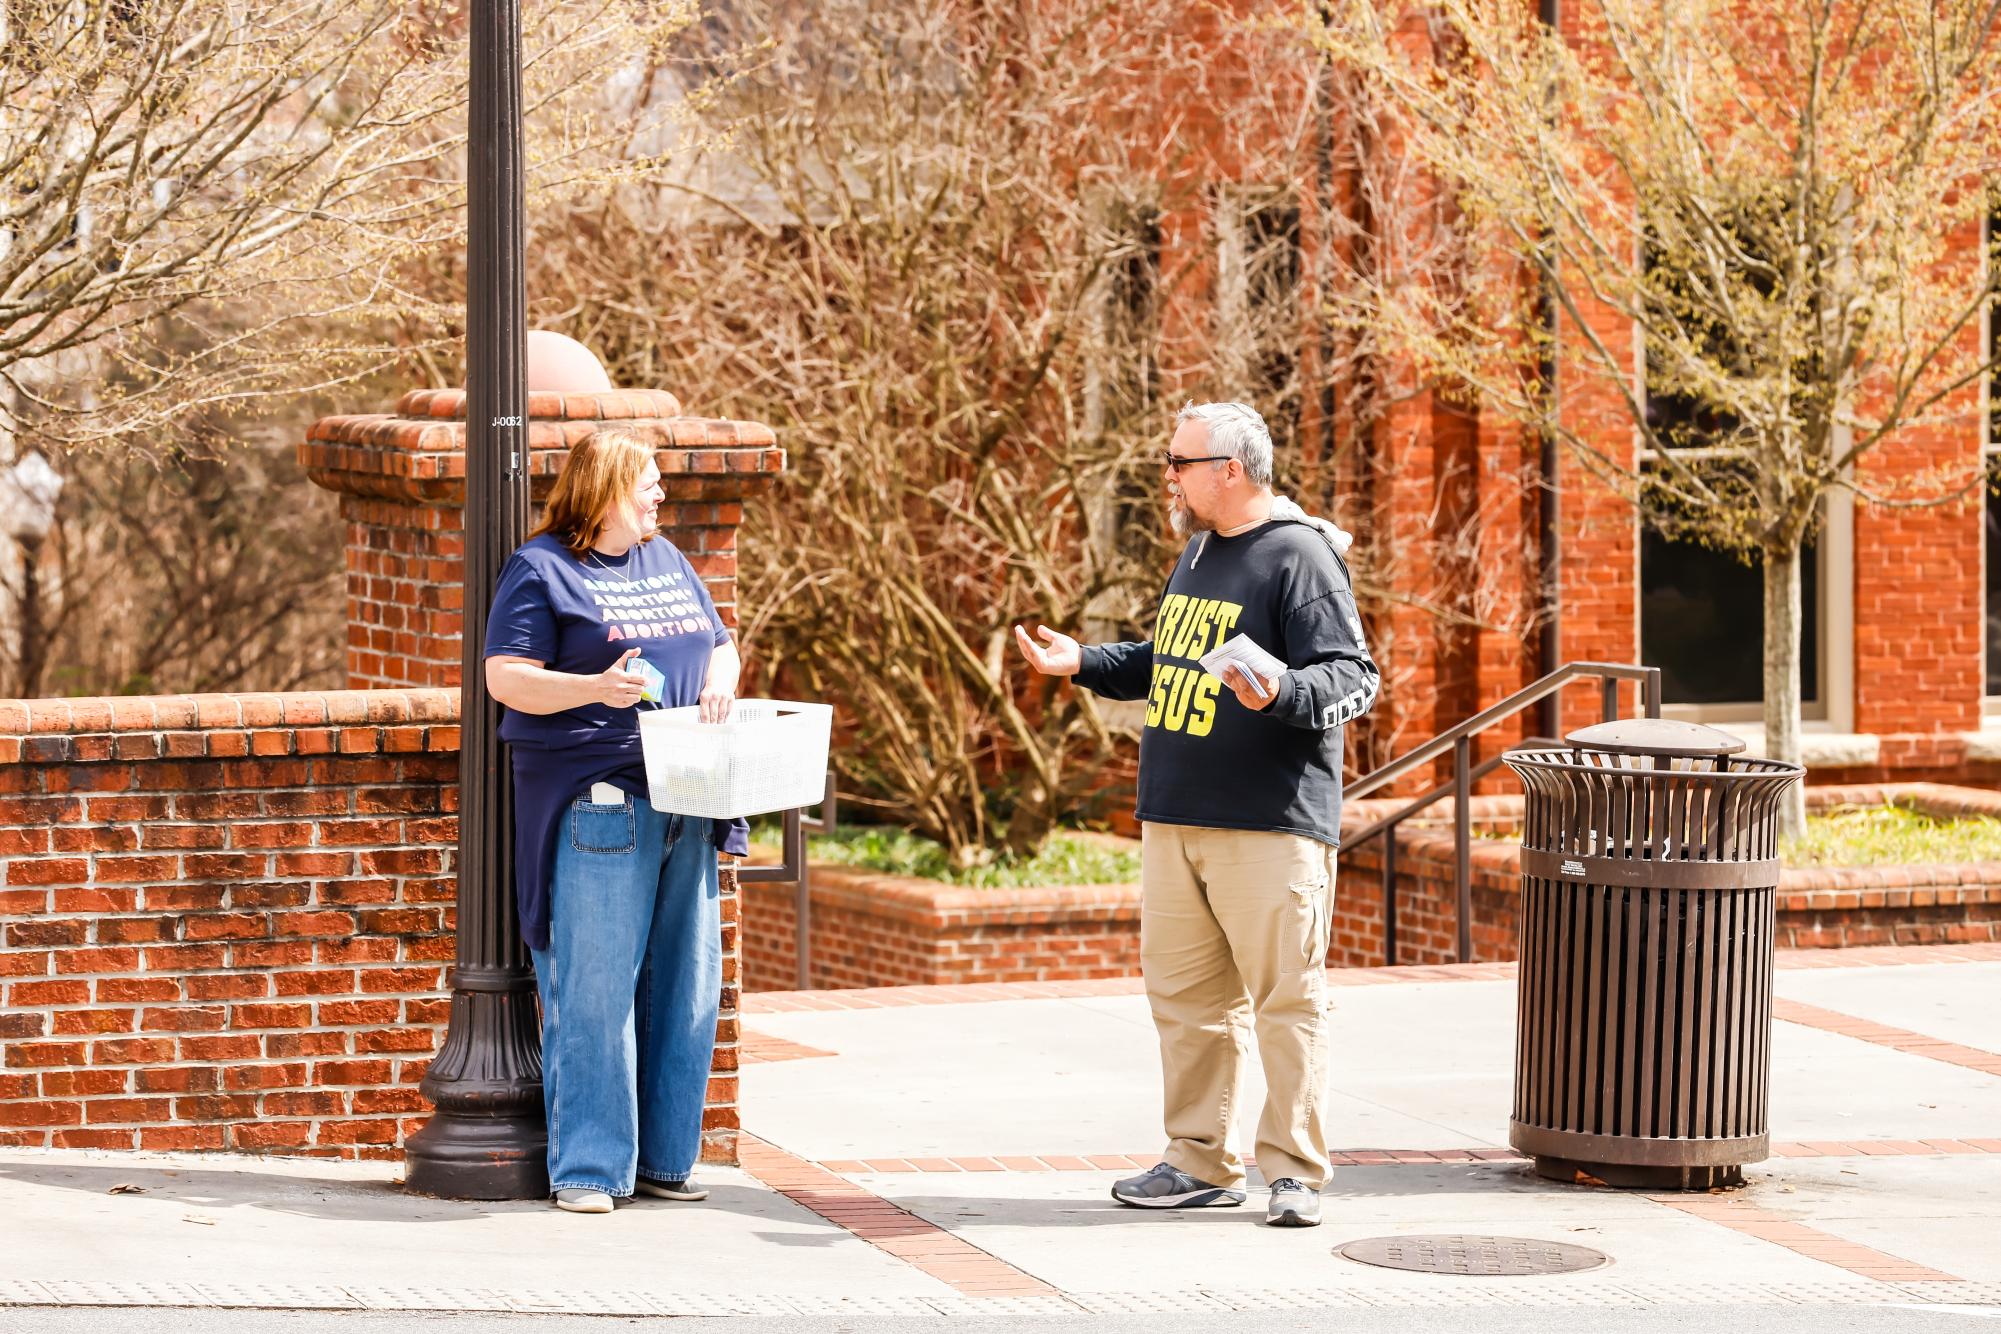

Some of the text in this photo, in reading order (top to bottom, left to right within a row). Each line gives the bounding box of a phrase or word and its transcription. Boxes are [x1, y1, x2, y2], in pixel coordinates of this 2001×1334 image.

[492, 417, 522, 426] J-0062
[608, 617, 711, 641] ABORTION
[1153, 593, 1243, 661] TRUST
